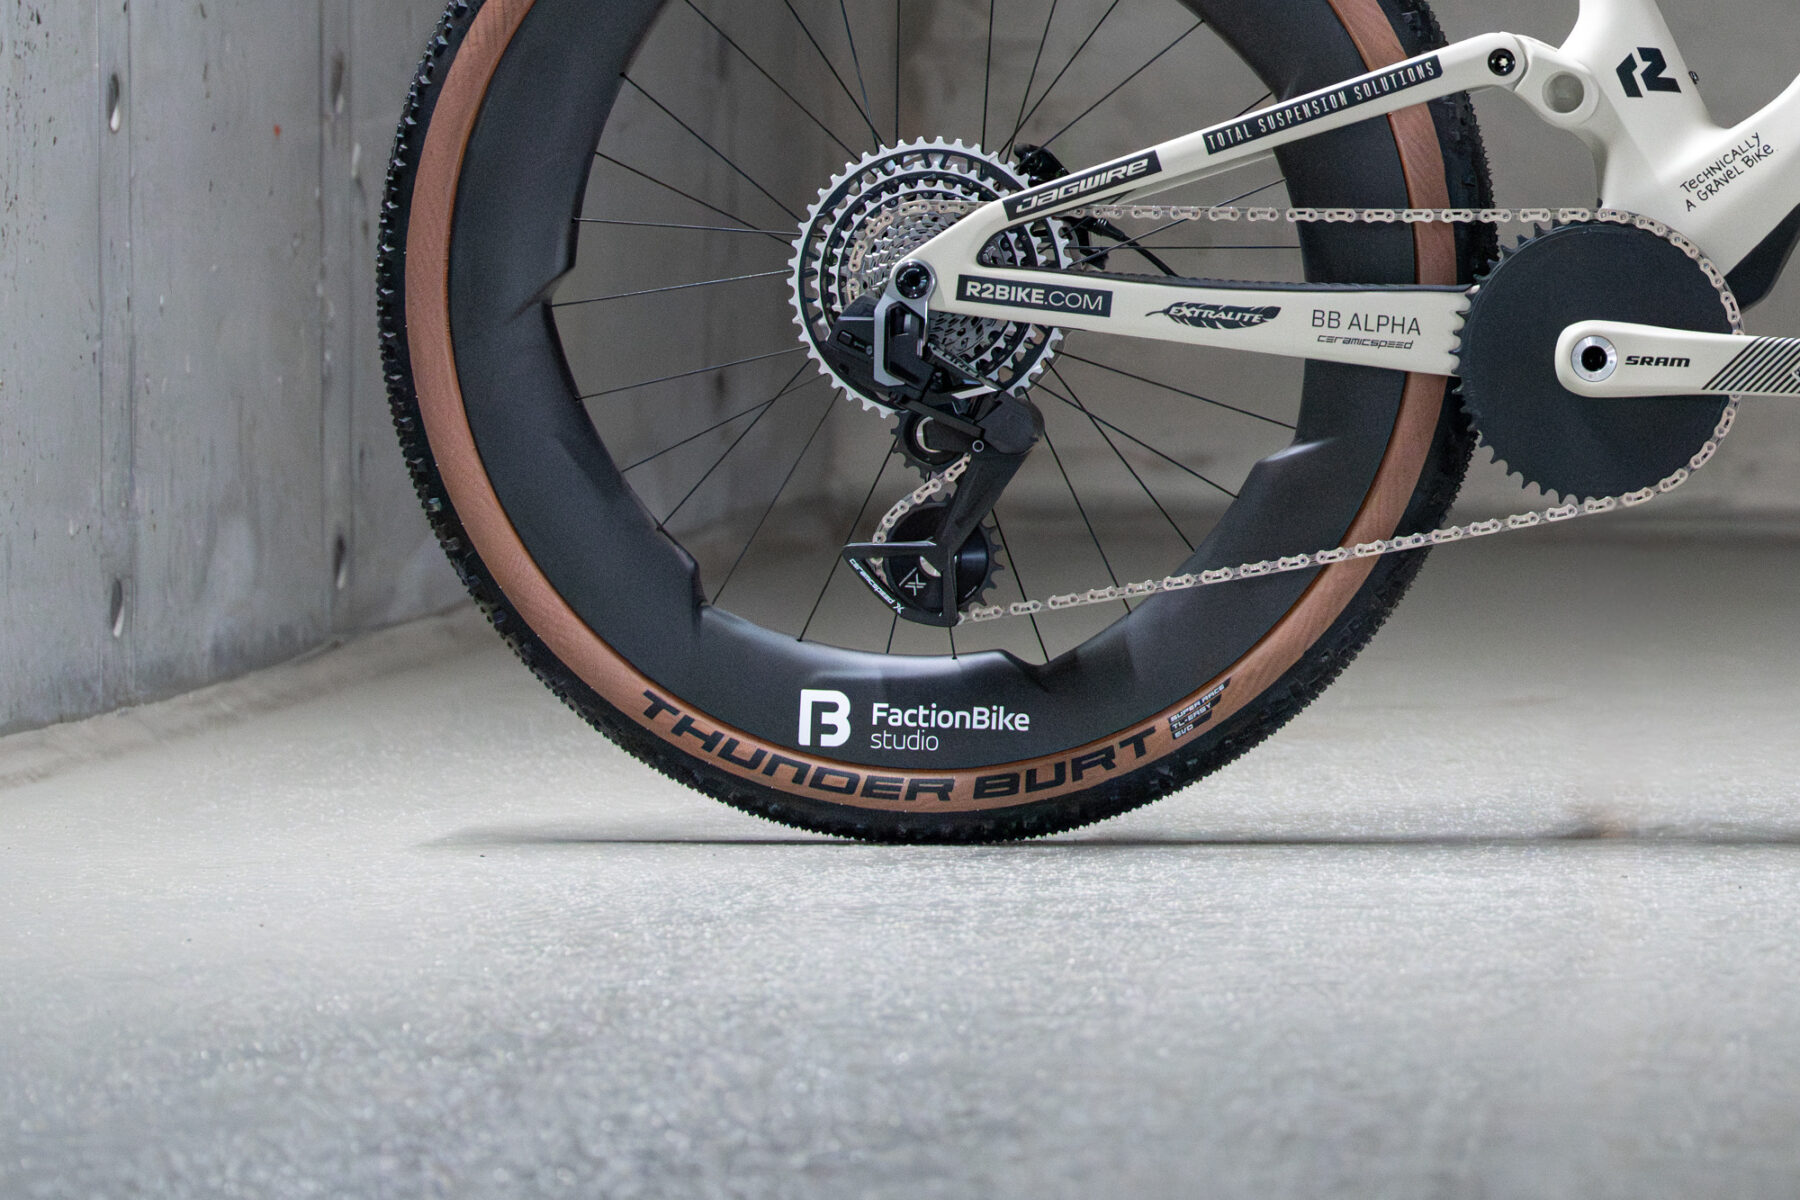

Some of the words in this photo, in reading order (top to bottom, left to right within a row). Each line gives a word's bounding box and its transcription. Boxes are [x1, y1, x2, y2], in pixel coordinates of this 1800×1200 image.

[1207, 124, 1252, 150] TOTAL
[1257, 90, 1348, 133] SUSPENSION
[1353, 61, 1435, 101] SOLUTIONS
[1685, 199, 1696, 212] A
[965, 281, 1103, 311] R2BIKE.COM
[1169, 306, 1264, 323] EXTRALITE
[1312, 309, 1341, 329] BB
[1347, 312, 1421, 336] ALPHA
[1625, 355, 1691, 368] SRAM
[1170, 700, 1201, 722] SUPER
[1201, 683, 1225, 704] RACE
[1172, 702, 1211, 729] TL-EASY
[872, 702, 1030, 732] FactionBike
[640, 688, 956, 802] THUNDER
[973, 726, 1160, 800] BURT
[870, 730, 939, 752] studio
